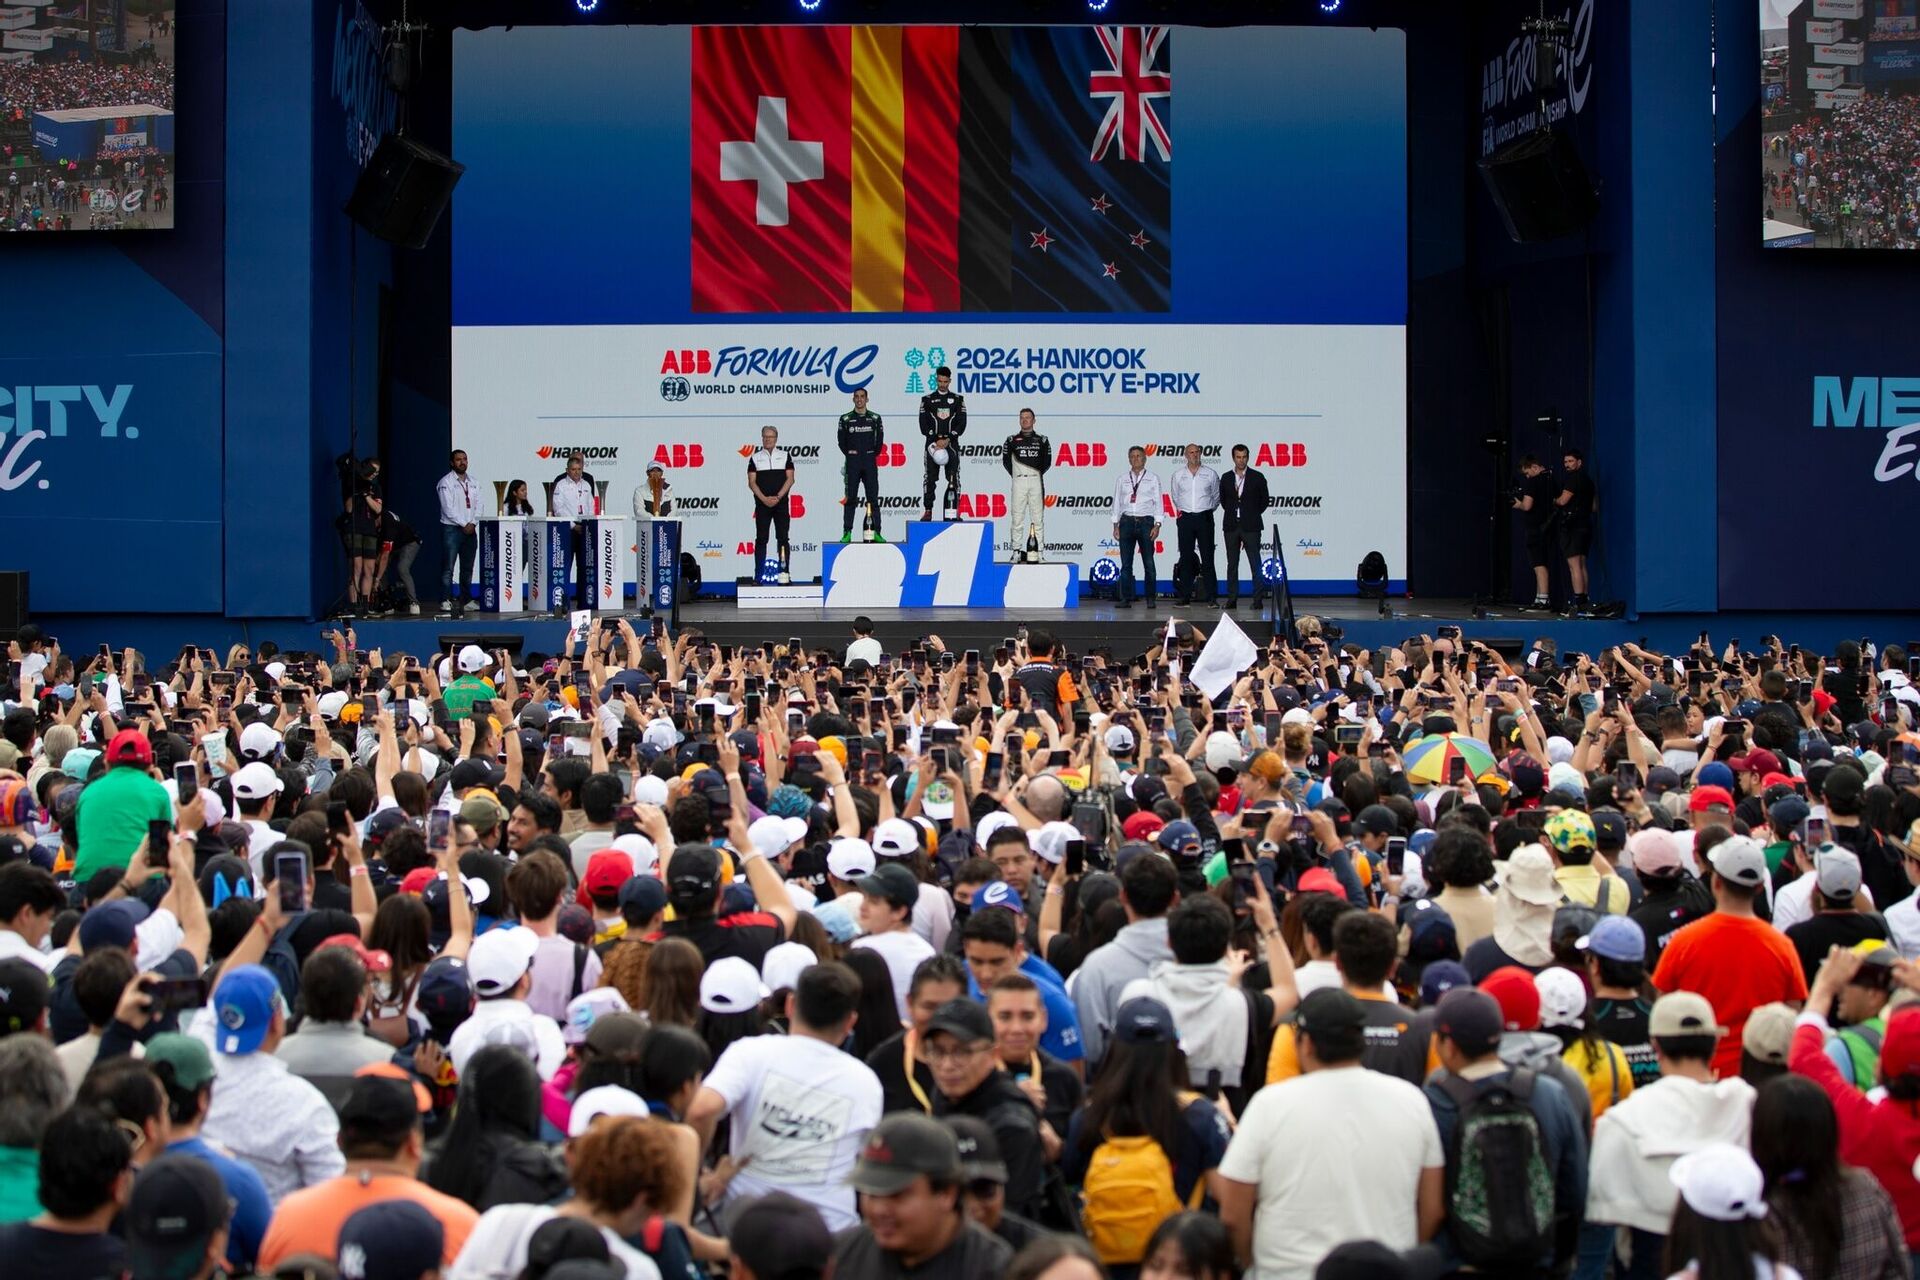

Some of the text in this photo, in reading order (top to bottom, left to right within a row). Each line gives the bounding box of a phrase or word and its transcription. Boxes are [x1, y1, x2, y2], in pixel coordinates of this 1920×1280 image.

[661, 350, 712, 374] ABB
[714, 346, 838, 377] FORMULA
[956, 348, 1146, 369] 2024 HANKOOK
[694, 384, 736, 394] WORLD
[740, 384, 831, 394] CHAMPIONSHIP
[957, 372, 1200, 393] MEXICO CITY E-PRIX
[653, 444, 704, 468] ABB
[876, 442, 907, 467] BB
[1055, 442, 1108, 467] ABB
[1255, 443, 1307, 467] ABB
[958, 493, 1008, 518] ABB
[1267, 496, 1322, 508] ANKOOK
[1272, 509, 1295, 517] driving
[736, 542, 755, 555] AB
[918, 522, 984, 606] 1
